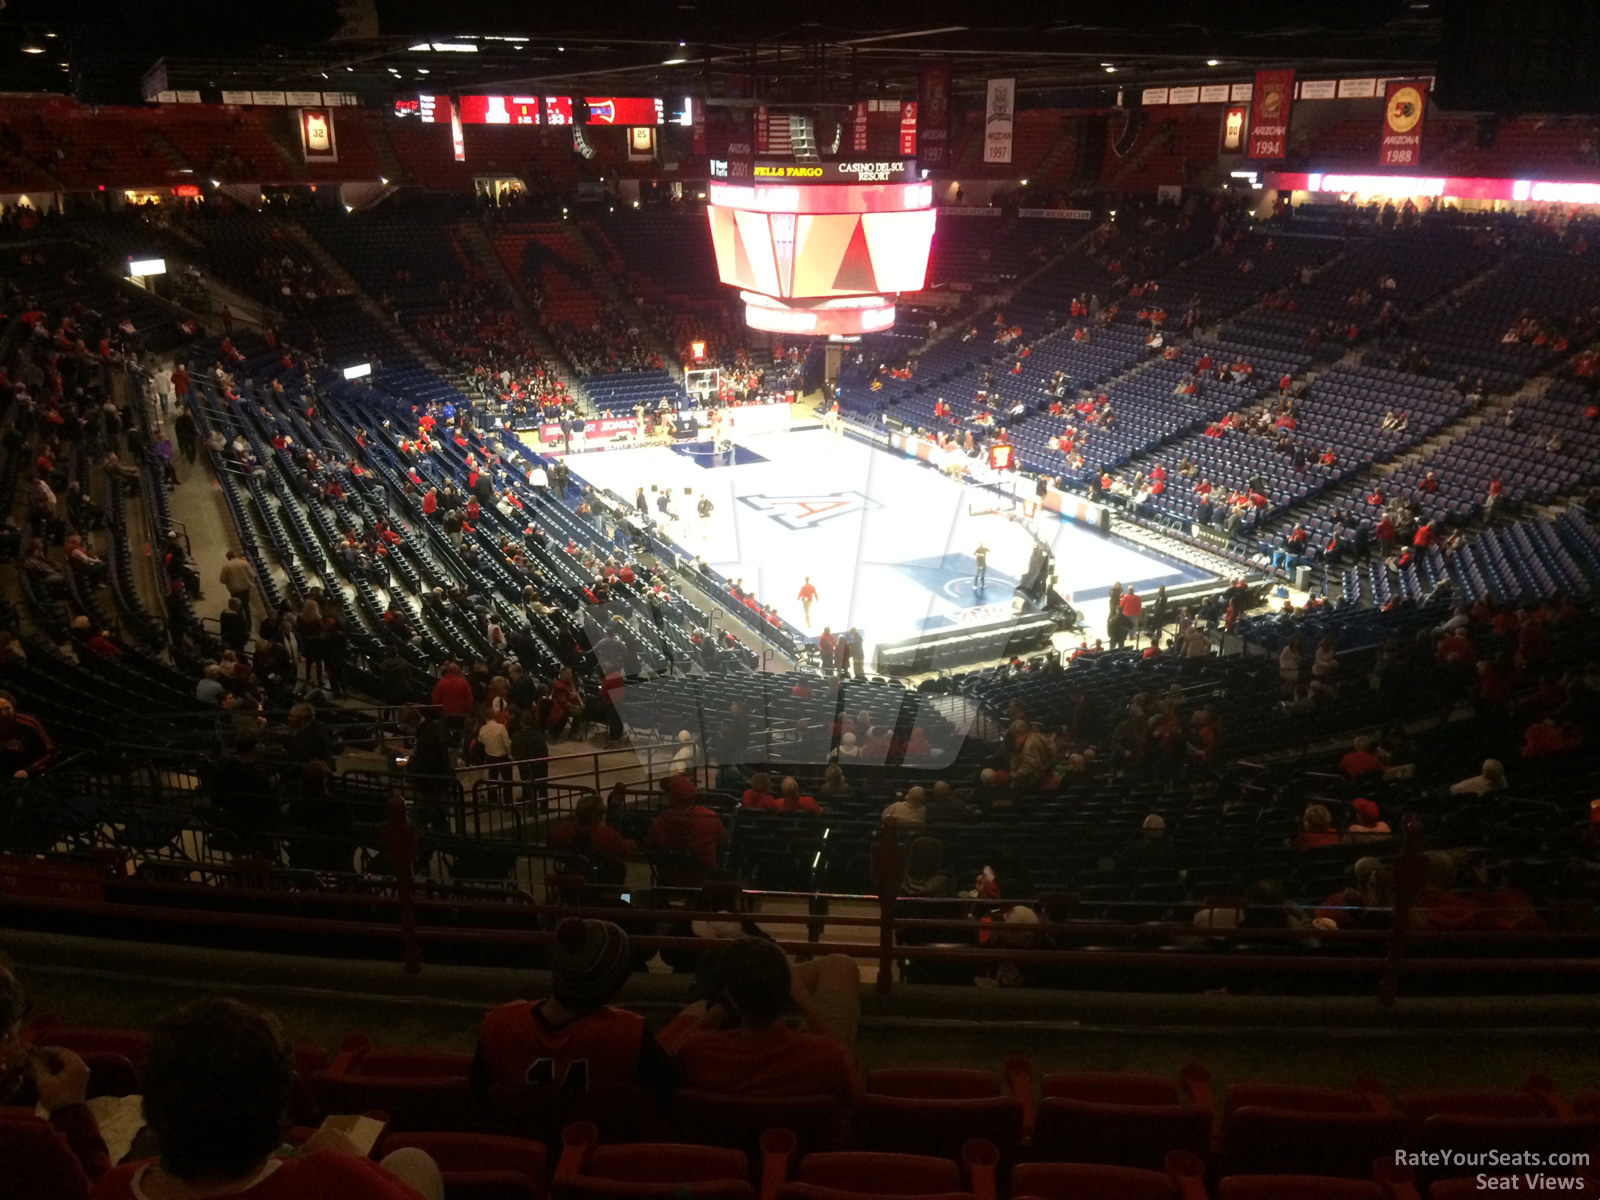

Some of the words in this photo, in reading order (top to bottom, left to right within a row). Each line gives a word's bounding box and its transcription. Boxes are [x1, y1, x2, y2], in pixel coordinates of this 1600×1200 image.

[312, 129, 324, 138] 32
[637, 130, 647, 138] 25
[1251, 126, 1286, 136] ARIZONA
[1383, 135, 1419, 145] ARIZONA
[990, 146, 1007, 159] 1997
[1256, 141, 1281, 155] 1994
[1386, 149, 1412, 163] 1988
[731, 161, 749, 177] 2001
[786, 167, 824, 178] FARGO
[838, 163, 875, 173] CASINO
[858, 171, 890, 181] RESORT
